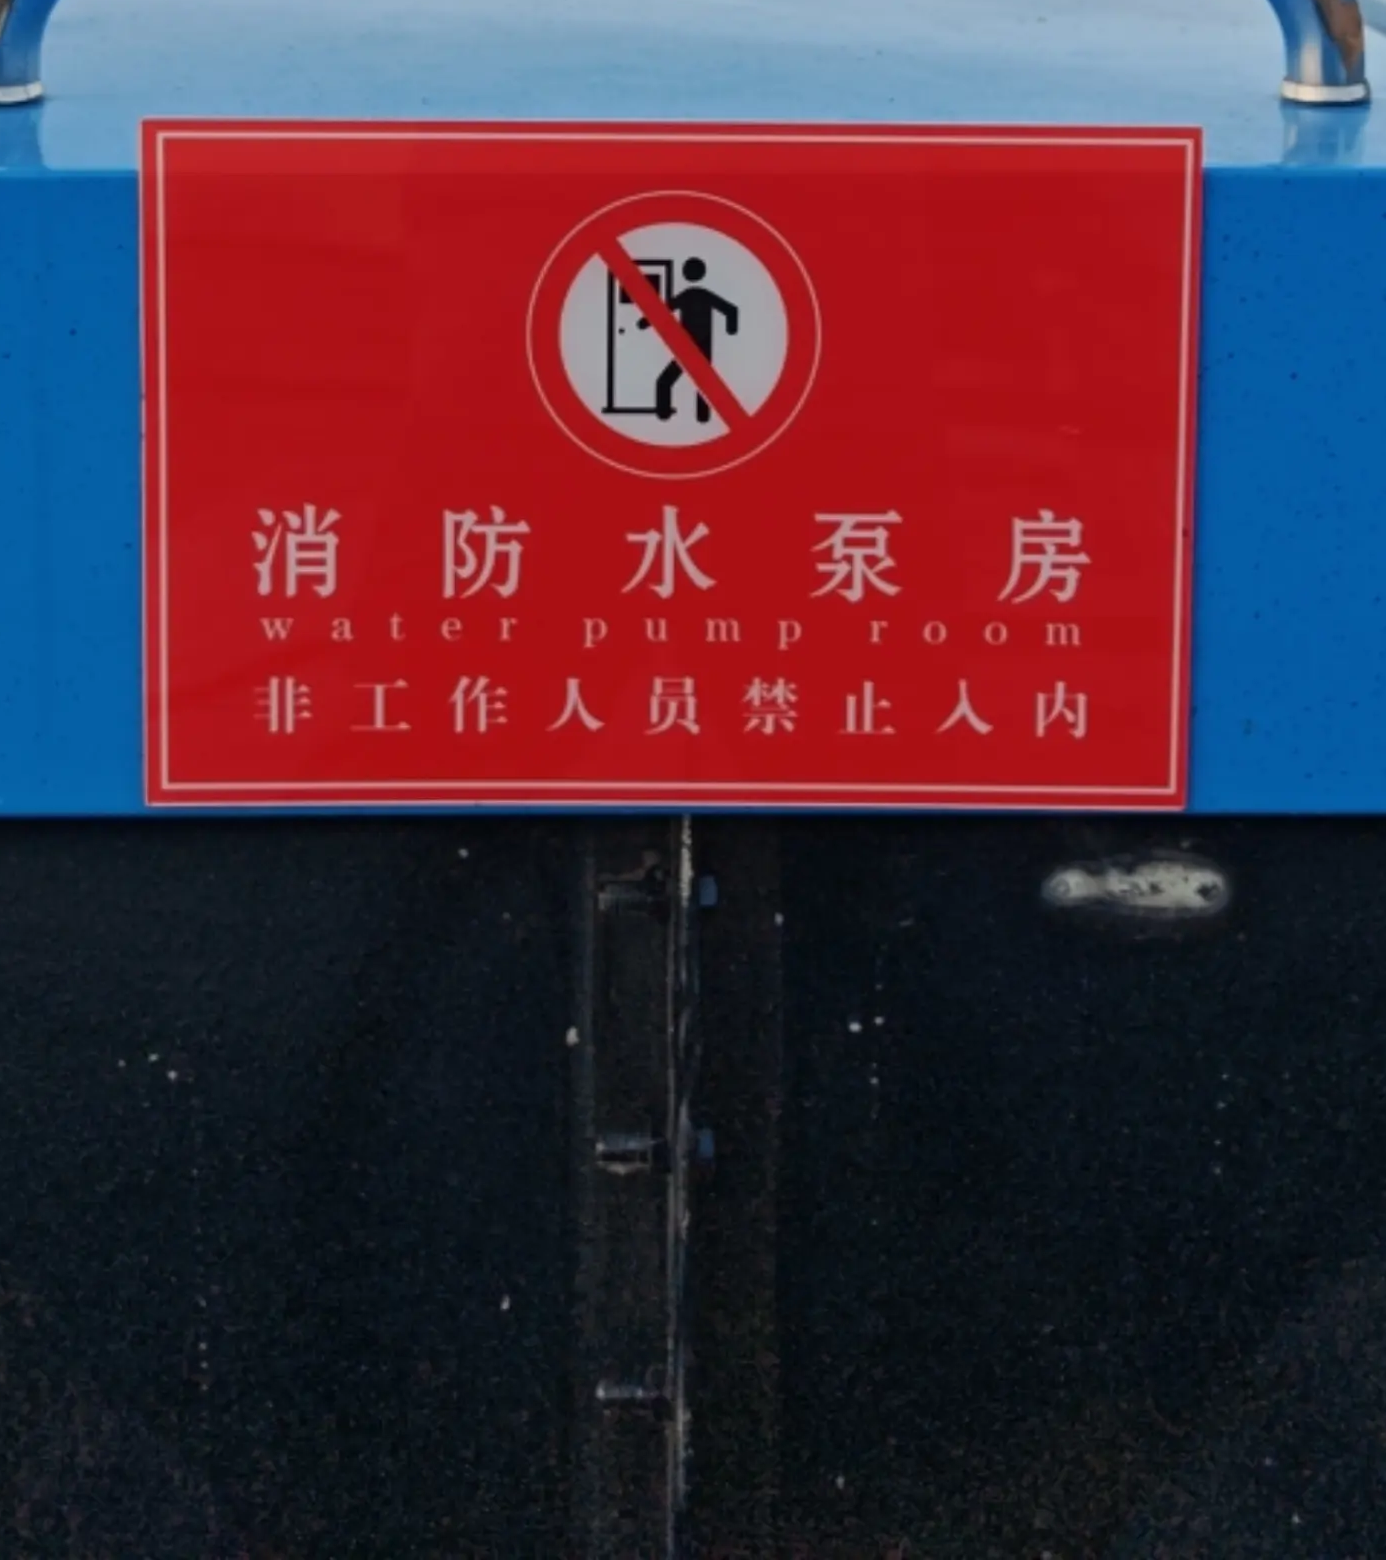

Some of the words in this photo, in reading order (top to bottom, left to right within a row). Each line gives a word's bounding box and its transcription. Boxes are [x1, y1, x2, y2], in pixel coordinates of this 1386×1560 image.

[251, 503, 1091, 603] 消防水泵房
[261, 612, 518, 642] water
[582, 617, 803, 649] pump
[869, 619, 1082, 647] room
[253, 675, 1089, 739] 非工作人员禁止入内
